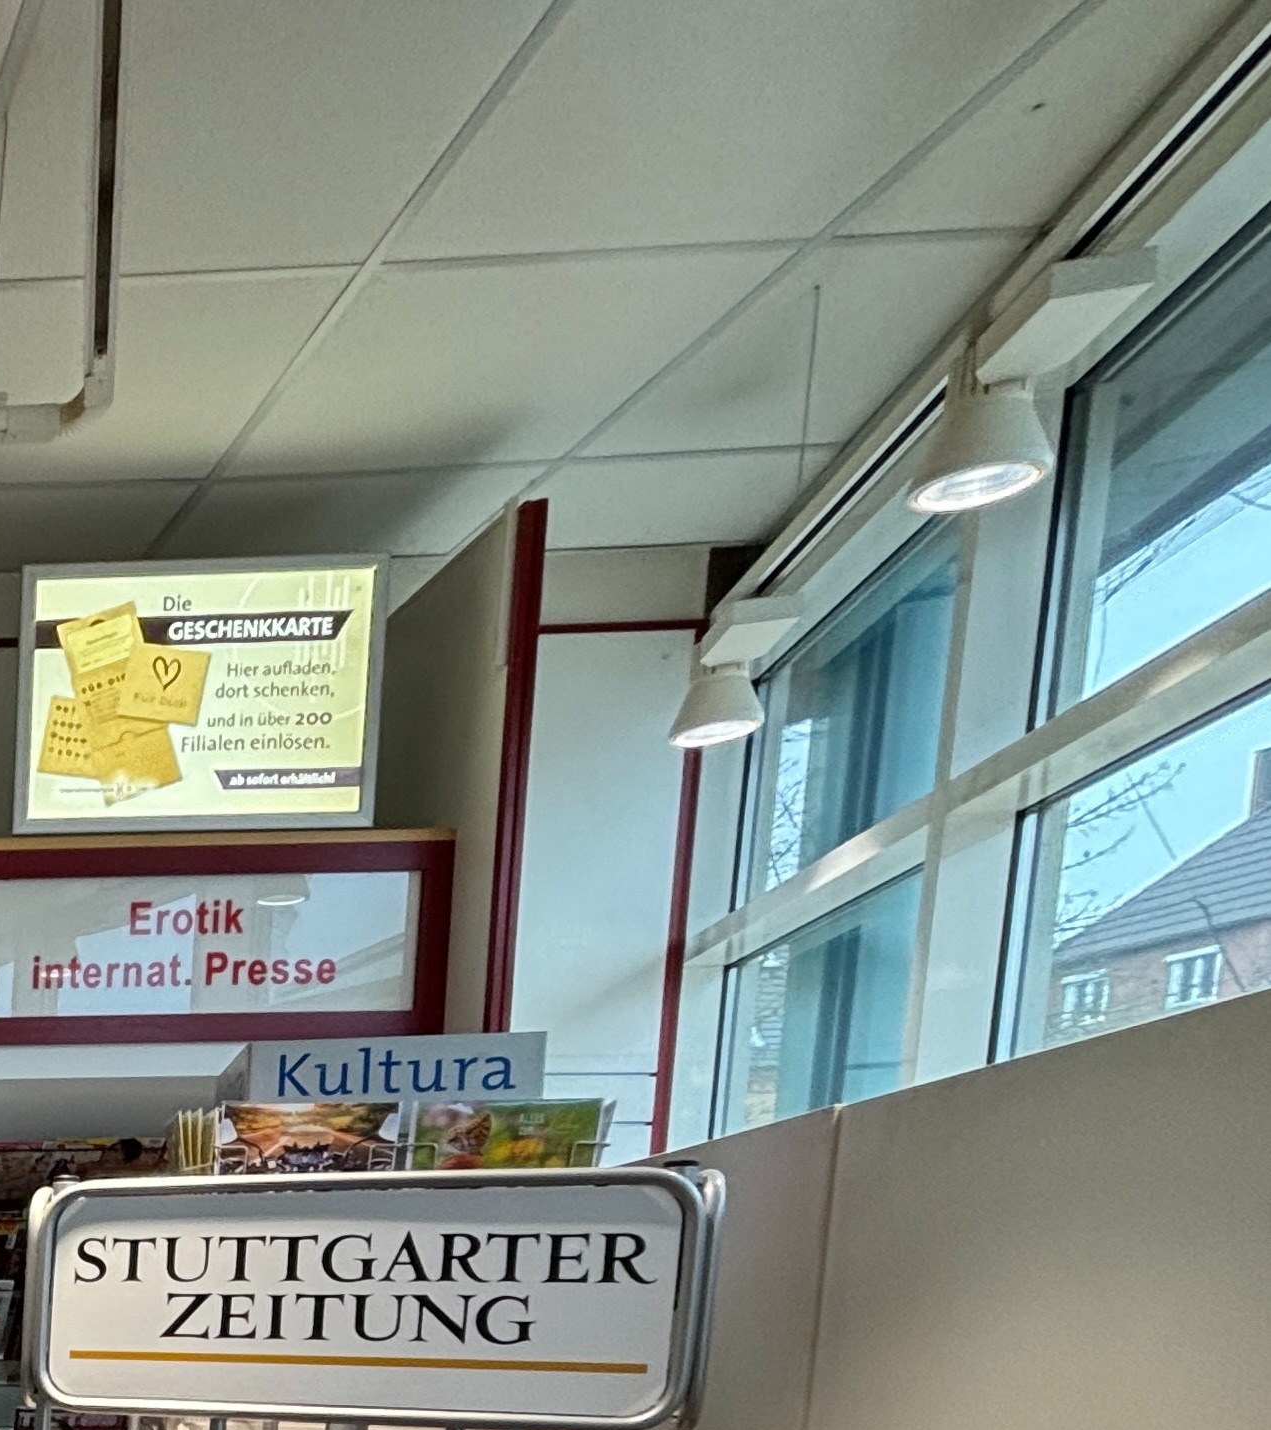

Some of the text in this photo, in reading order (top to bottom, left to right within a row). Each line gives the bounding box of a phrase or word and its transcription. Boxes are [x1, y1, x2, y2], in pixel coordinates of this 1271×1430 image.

[162, 596, 192, 612] Die
[168, 616, 334, 642] GESCHENKKARTE
[227, 660, 337, 677] Hier aufladen,
[215, 682, 335, 699] dort schenken,
[207, 711, 333, 728] und in über 200
[181, 733, 331, 752] Filialen einlösen.
[129, 900, 244, 936] Erotik
[31, 948, 337, 990] internat. Presse
[278, 1047, 516, 1098] Kultura
[73, 1231, 658, 1286] STUTTGARTER
[160, 1293, 537, 1346] ZEITUNG
